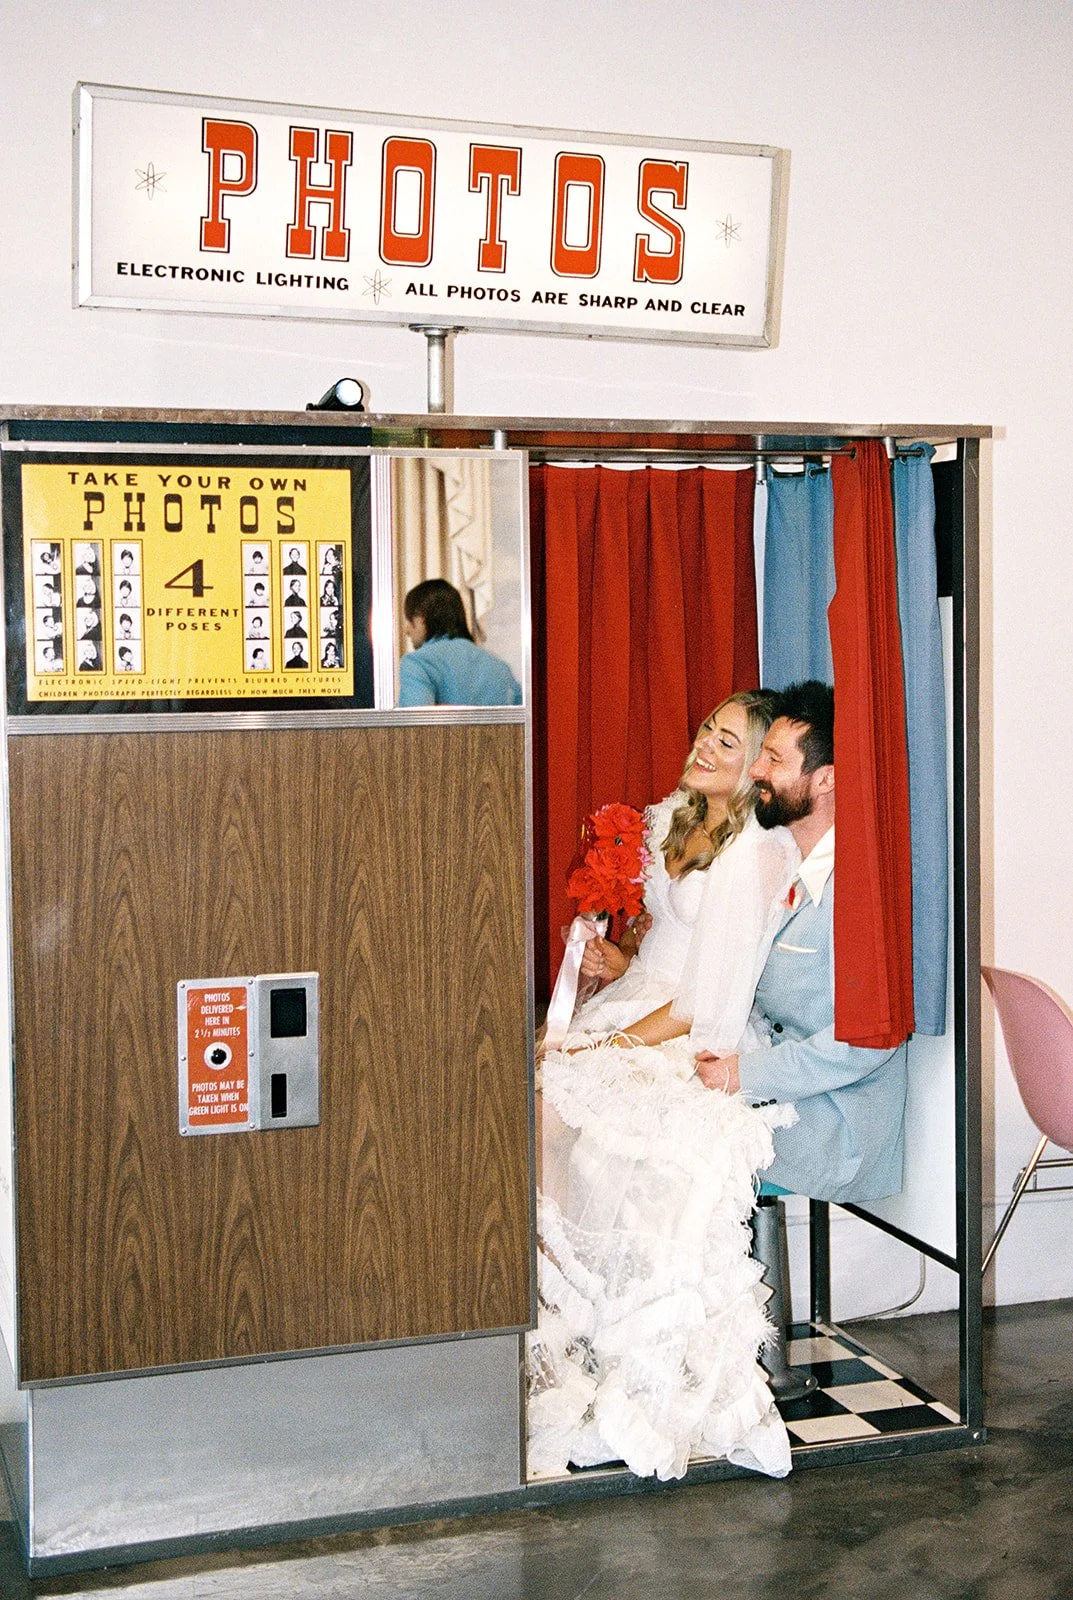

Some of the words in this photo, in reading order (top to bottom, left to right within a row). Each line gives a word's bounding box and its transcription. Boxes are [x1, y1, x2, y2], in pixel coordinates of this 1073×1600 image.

[199, 116, 689, 285] PHOTOS
[117, 262, 245, 284] ELECTRONIC
[256, 271, 349, 291] LIGHTING
[405, 283, 438, 297] ALL
[447, 285, 521, 302] PHOTOS
[532, 291, 568, 306] ARE
[579, 294, 638, 310] SHARP
[645, 298, 682, 313] AND
[690, 301, 745, 317] CLEAR
[68, 472, 139, 487] TAKE
[158, 474, 231, 490] YOUR
[249, 477, 308, 492] OWN
[83, 491, 296, 535] PHOTOS
[164, 559, 214, 598] 4
[146, 608, 240, 618] DIFFERENT
[166, 622, 223, 632] POSES
[188, 677, 237, 685] PREVENTS
[204, 993, 230, 1002] PHOTOS
[200, 1005, 234, 1015] DELIVERED
[205, 1016, 220, 1026] HERE
[222, 1016, 230, 1025] IN
[194, 1030, 200, 1039] 2
[213, 1027, 240, 1037] MINUTES
[192, 1082, 217, 1092] PHOTOS
[219, 1081, 235, 1090] MAY
[236, 1080, 245, 1089] BE
[198, 1093, 218, 1103] TAKEN
[221, 1091, 239, 1101] WHEN
[189, 1106, 209, 1116] GREEN
[210, 1104, 229, 1114] LIGHT
[231, 1103, 237, 1113] IS
[239, 1102, 248, 1112] ON
